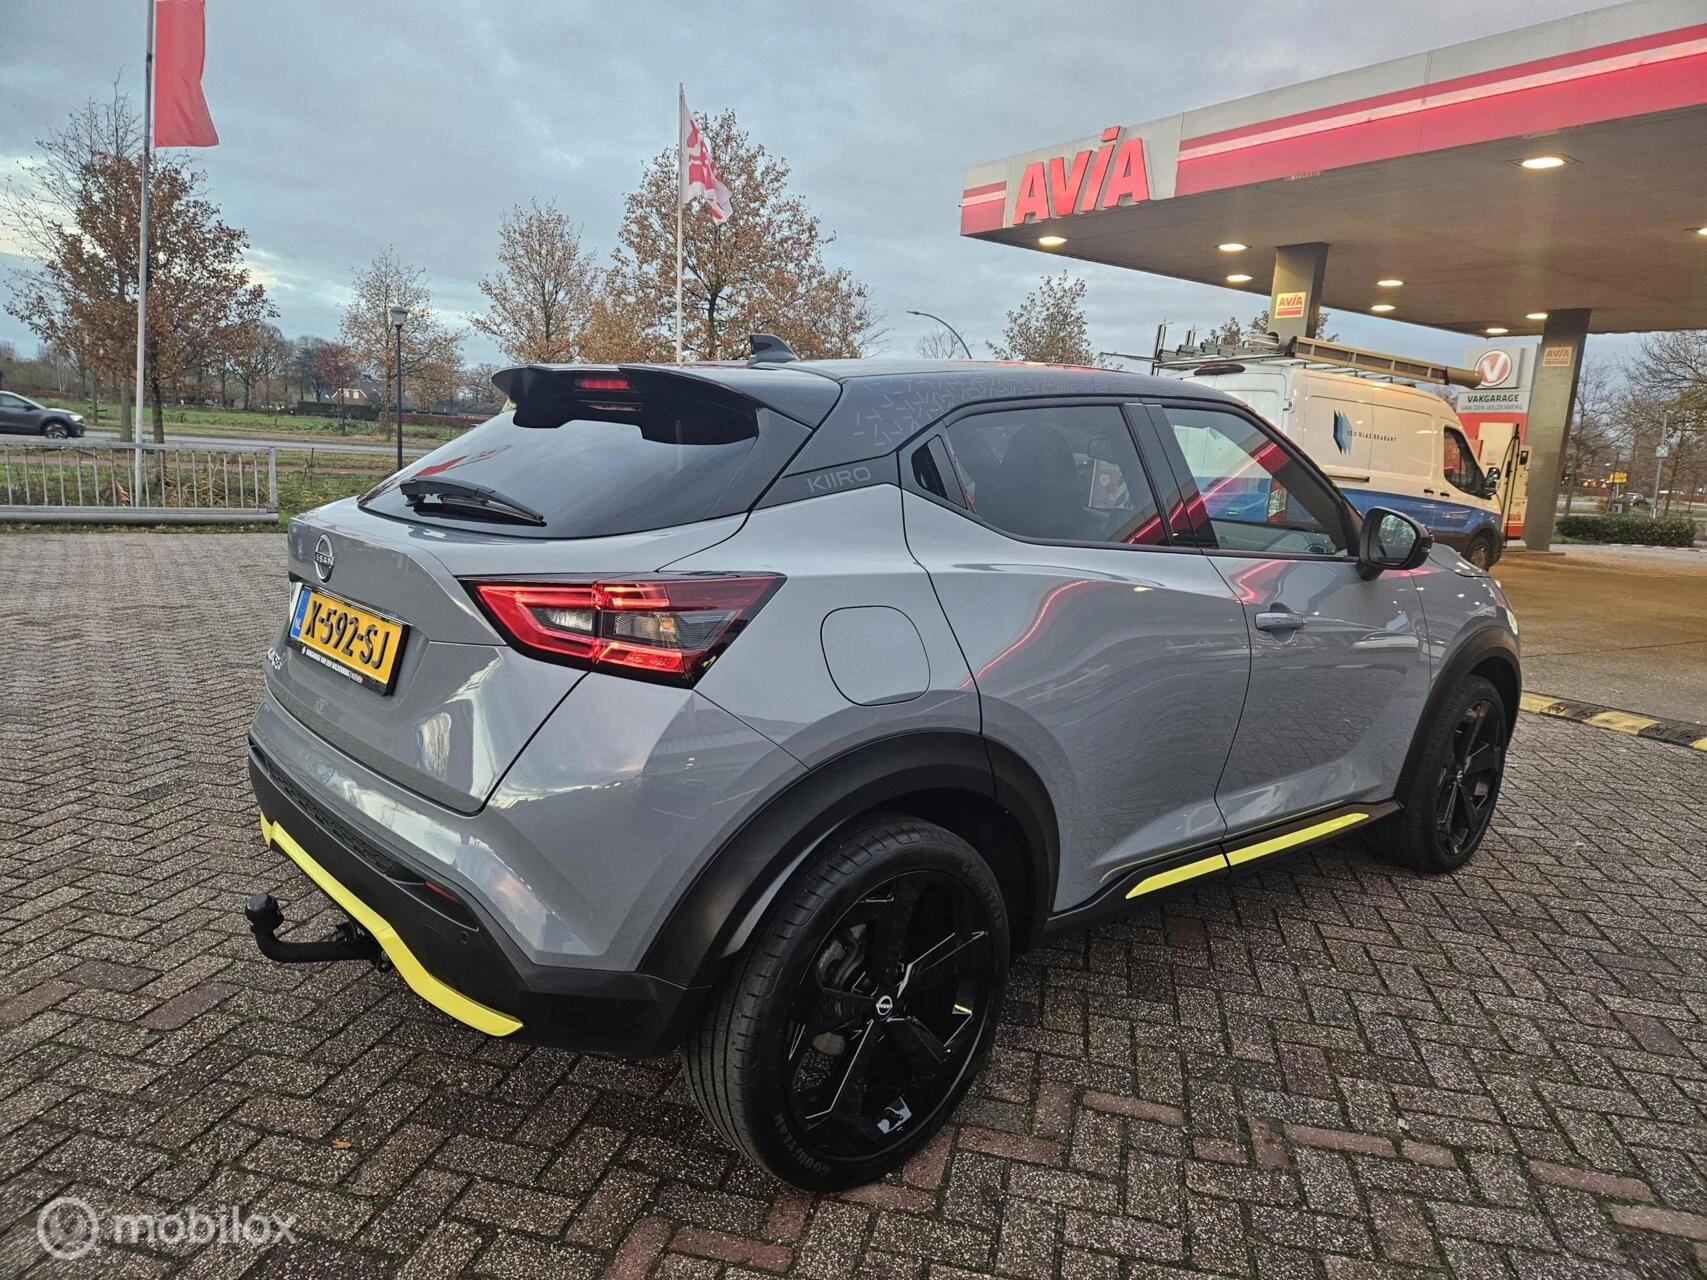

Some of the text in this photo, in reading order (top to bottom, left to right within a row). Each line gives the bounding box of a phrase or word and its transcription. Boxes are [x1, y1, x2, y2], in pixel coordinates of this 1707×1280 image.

[1012, 125, 1150, 226] AVIA
[1278, 294, 1303, 307] AVIA
[1467, 394, 1520, 403] VAKGARAGE
[807, 466, 871, 493] KIIRO
[305, 600, 391, 670] X-592-SJ
